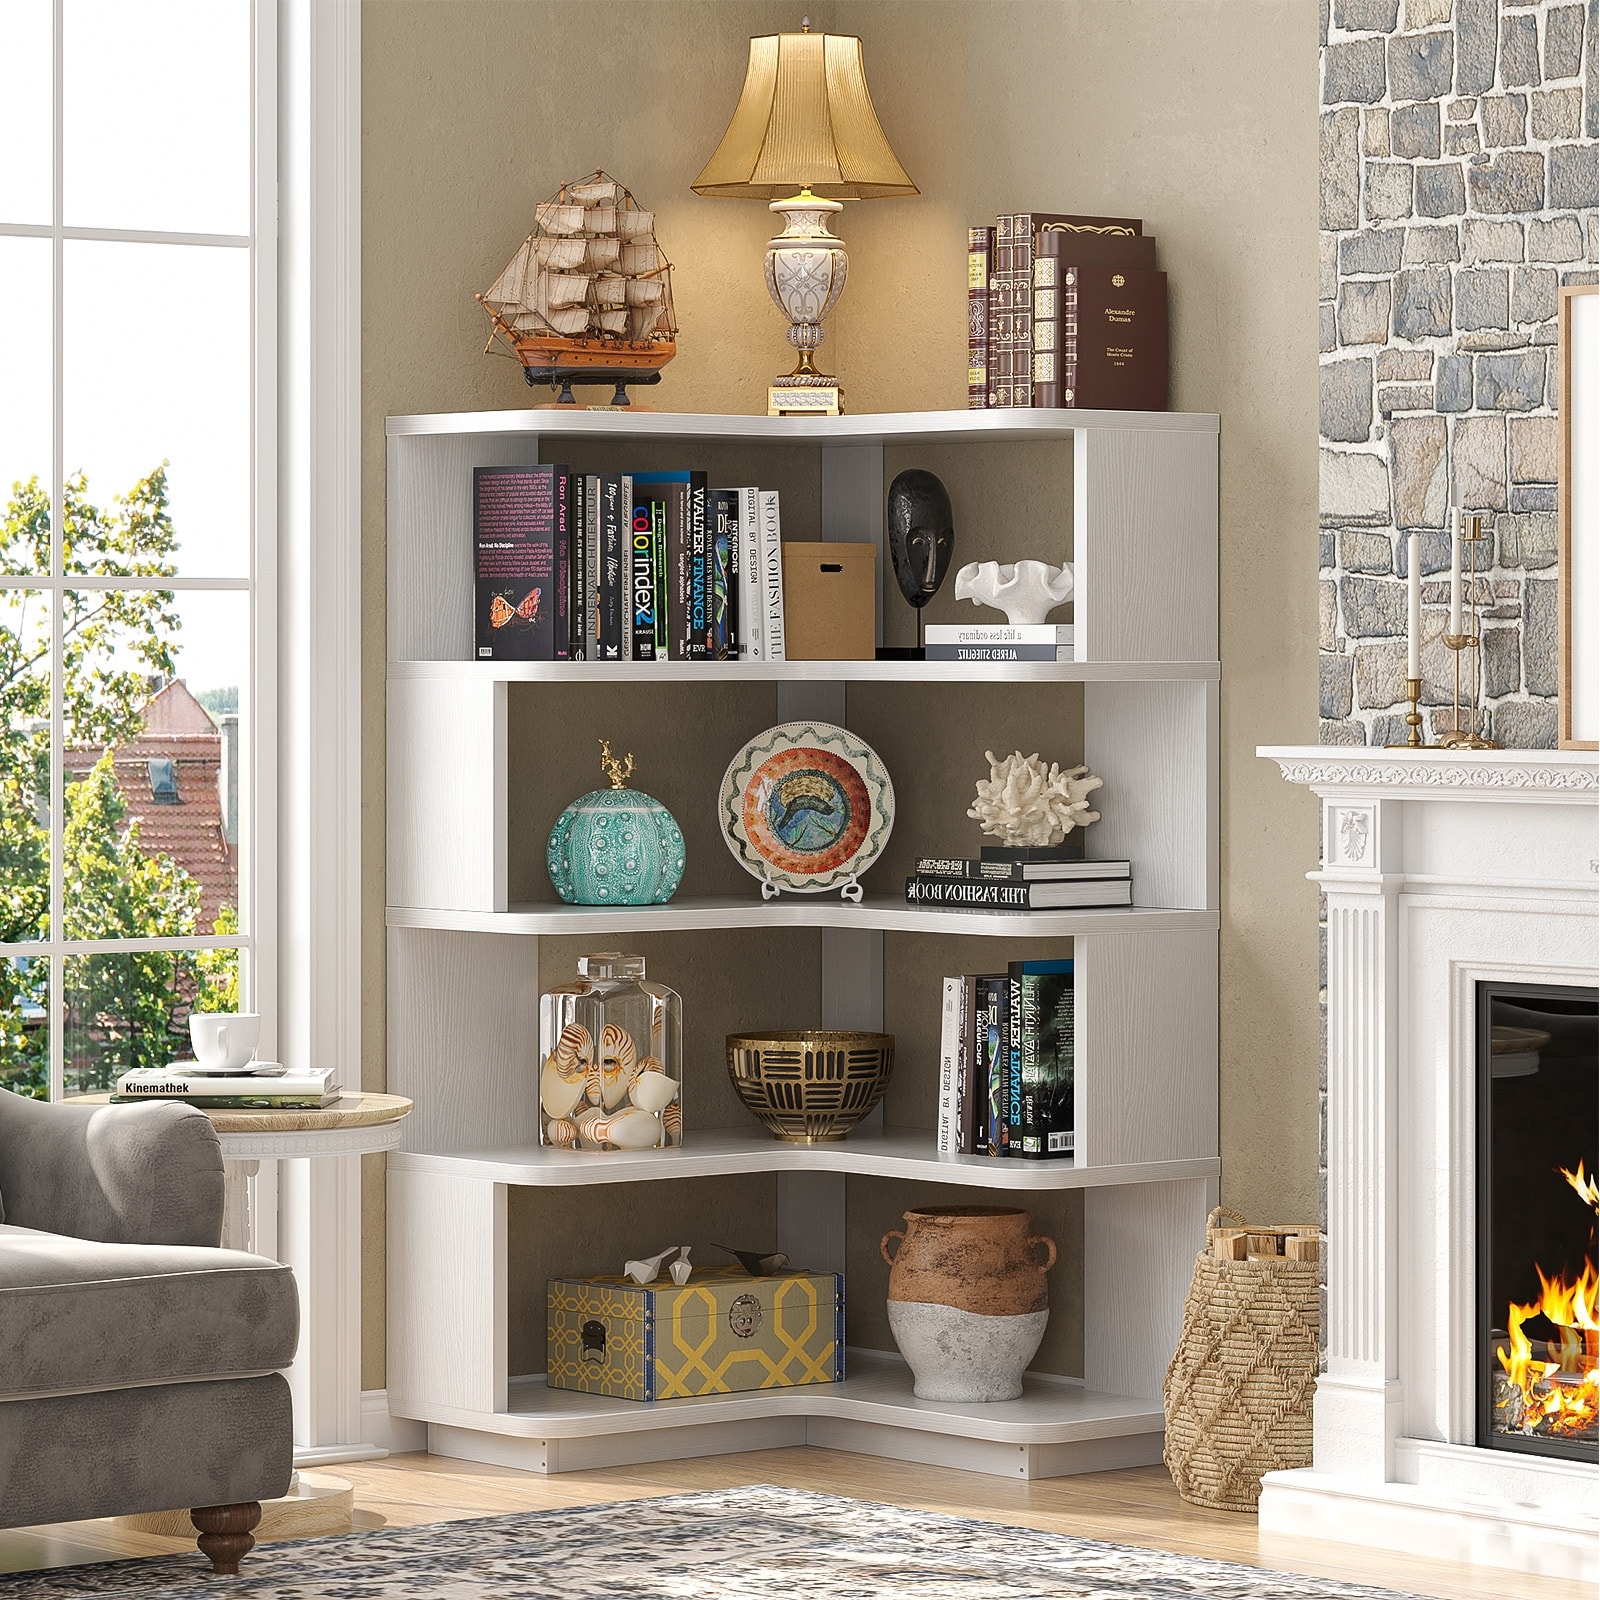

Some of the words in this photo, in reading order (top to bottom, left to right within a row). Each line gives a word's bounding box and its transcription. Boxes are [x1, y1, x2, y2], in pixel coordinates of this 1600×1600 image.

[1104, 308, 1136, 316] Alexandre
[693, 487, 704, 554] WALTER
[749, 532, 756, 543] BY
[765, 496, 777, 542] BOOK
[559, 540, 567, 557] No
[587, 488, 596, 636] INNENARCHITEKTUR
[558, 560, 567, 617] Discipline
[693, 556, 704, 629] FINANCE
[768, 548, 780, 619] FASHION
[770, 624, 781, 659] THE
[125, 1083, 189, 1093] Kinemathek
